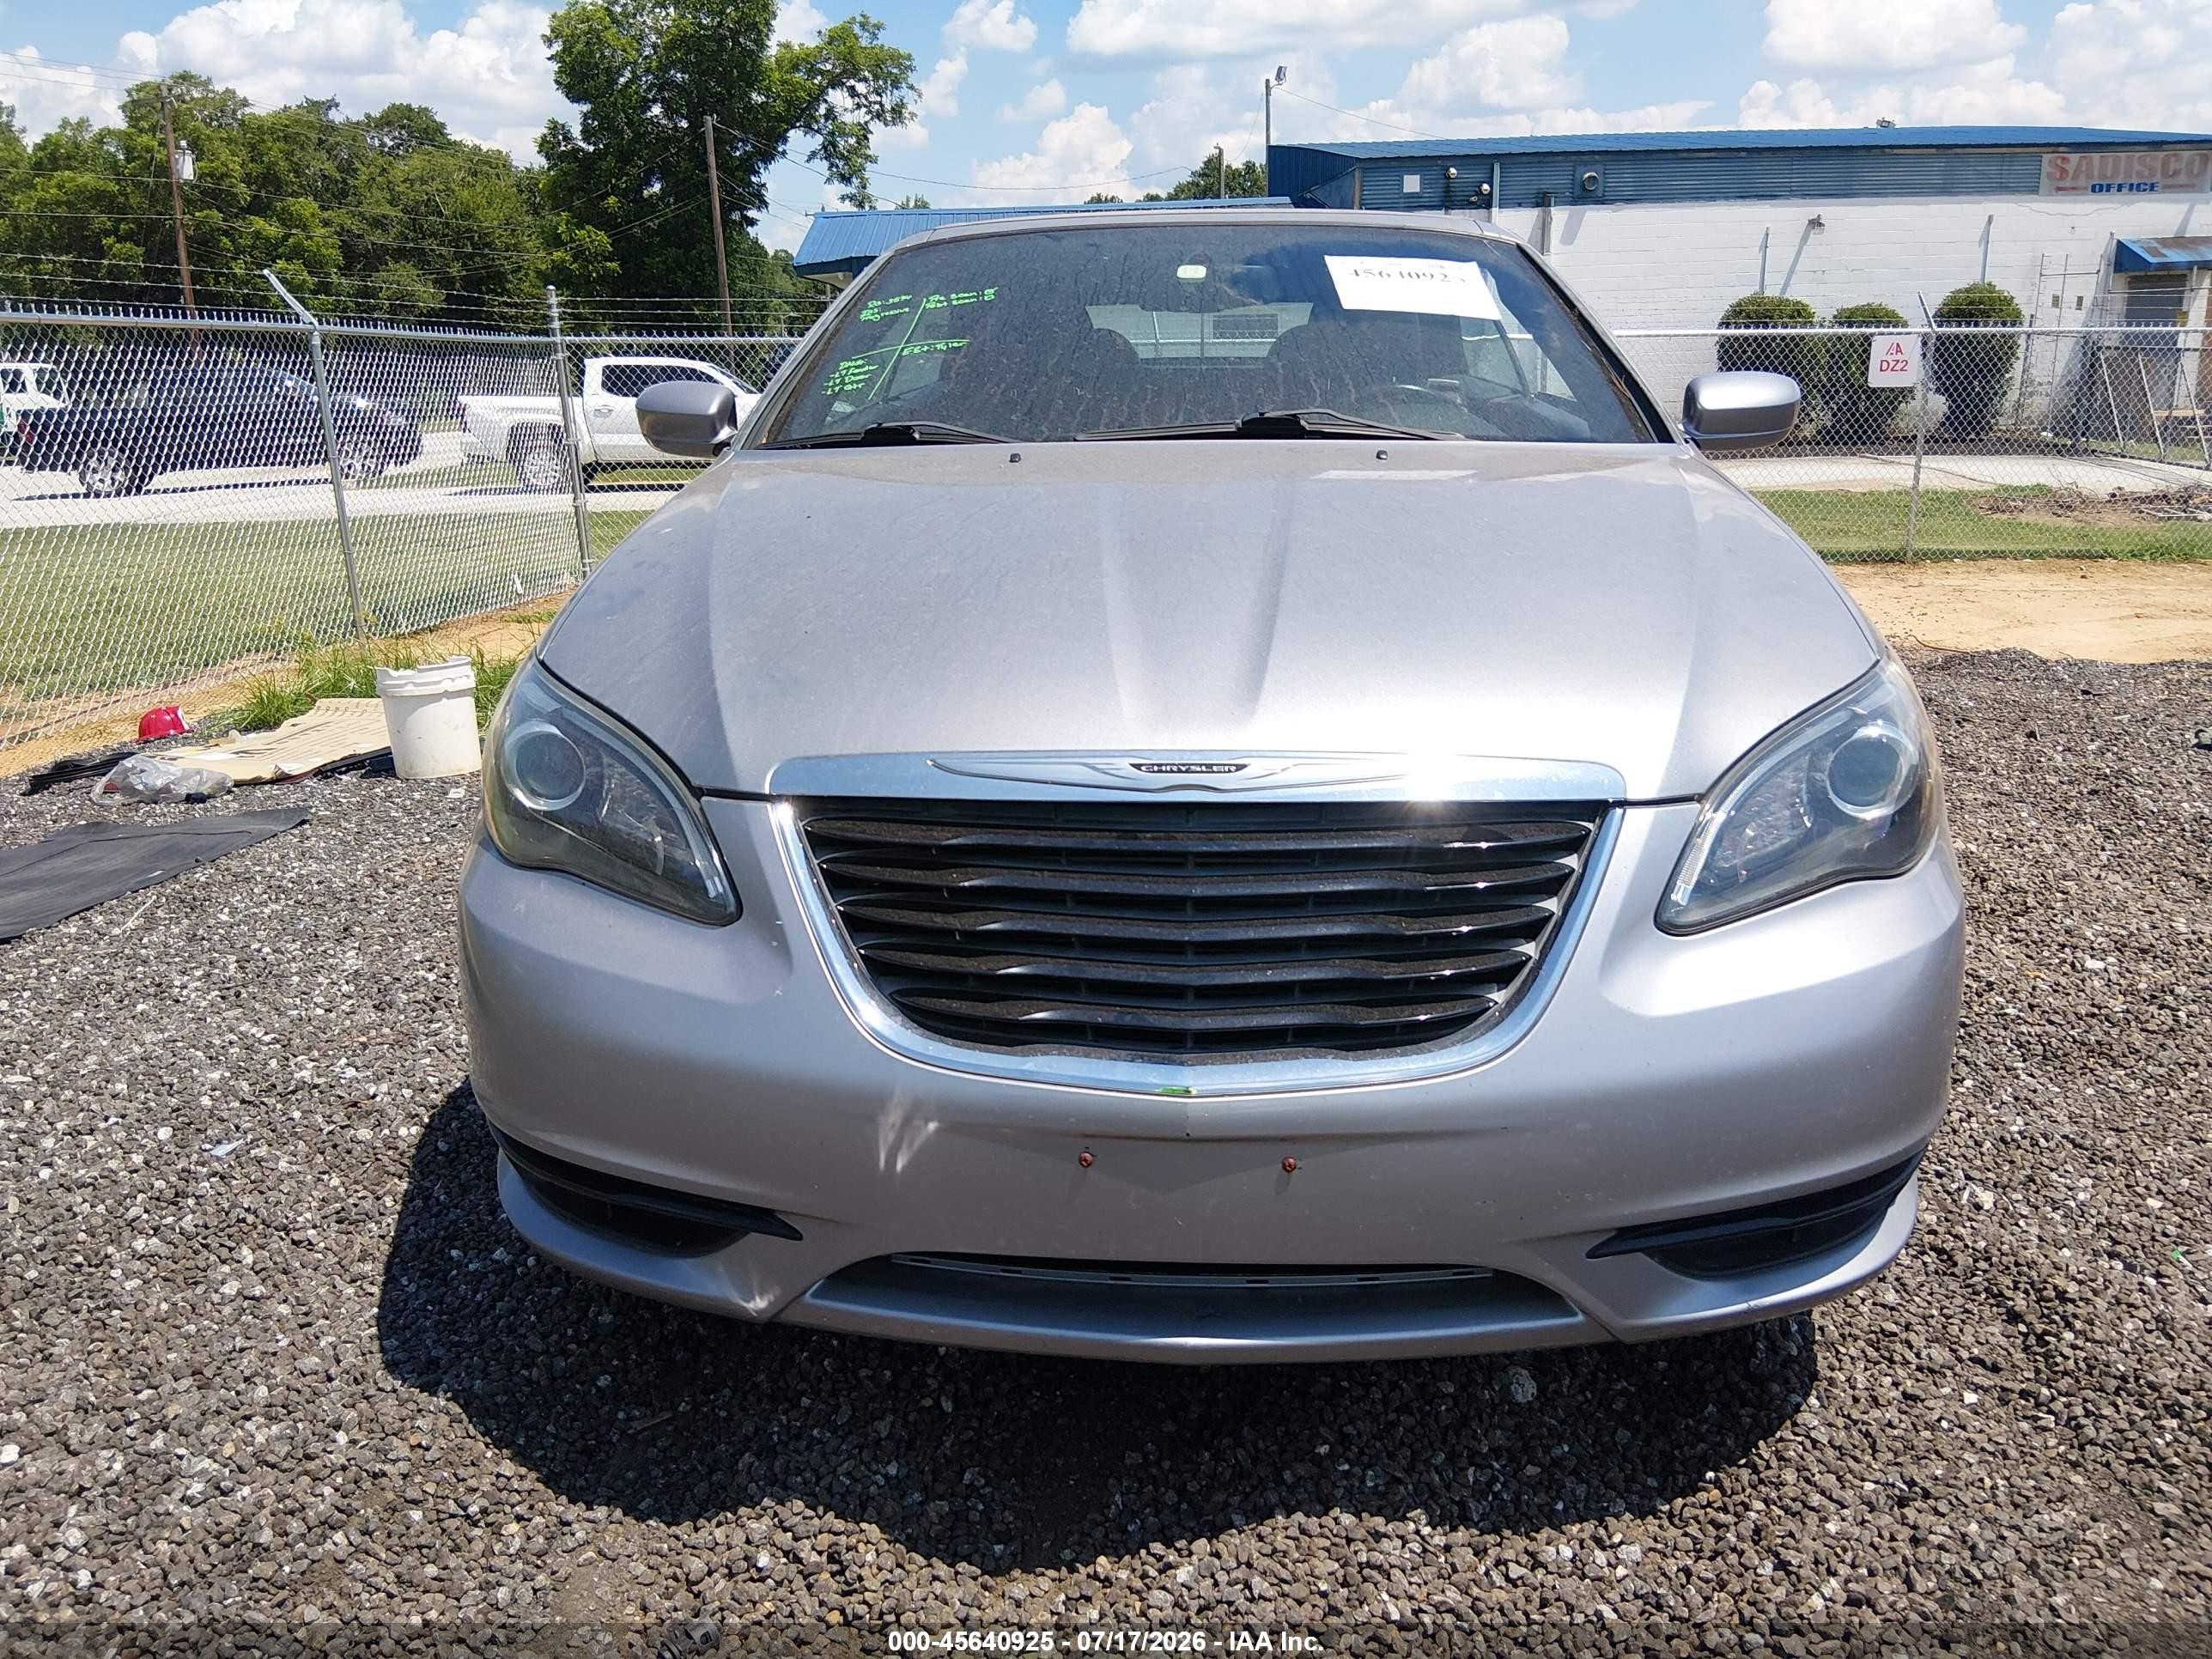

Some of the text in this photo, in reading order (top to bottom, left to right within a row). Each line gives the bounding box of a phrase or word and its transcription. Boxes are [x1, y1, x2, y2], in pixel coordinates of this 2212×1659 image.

[2046, 152, 2209, 181] SADISCO
[2090, 182, 2160, 193] OFFICE
[1879, 359, 1909, 372] DZ2
